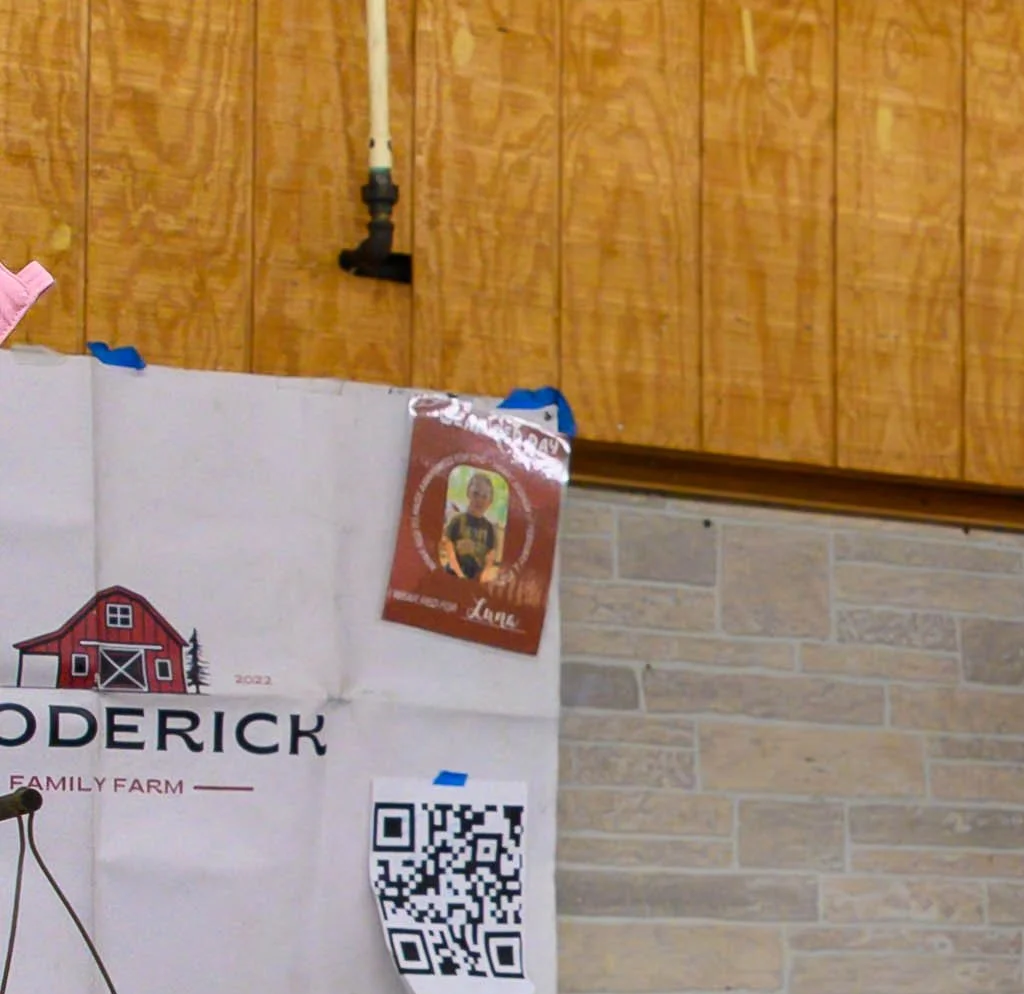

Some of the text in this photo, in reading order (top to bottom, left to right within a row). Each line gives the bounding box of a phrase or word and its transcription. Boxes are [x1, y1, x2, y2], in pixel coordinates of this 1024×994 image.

[234, 674, 273, 686] 2022
[0, 702, 328, 757] ODERICK
[10, 774, 184, 795] FAMILY FARM
